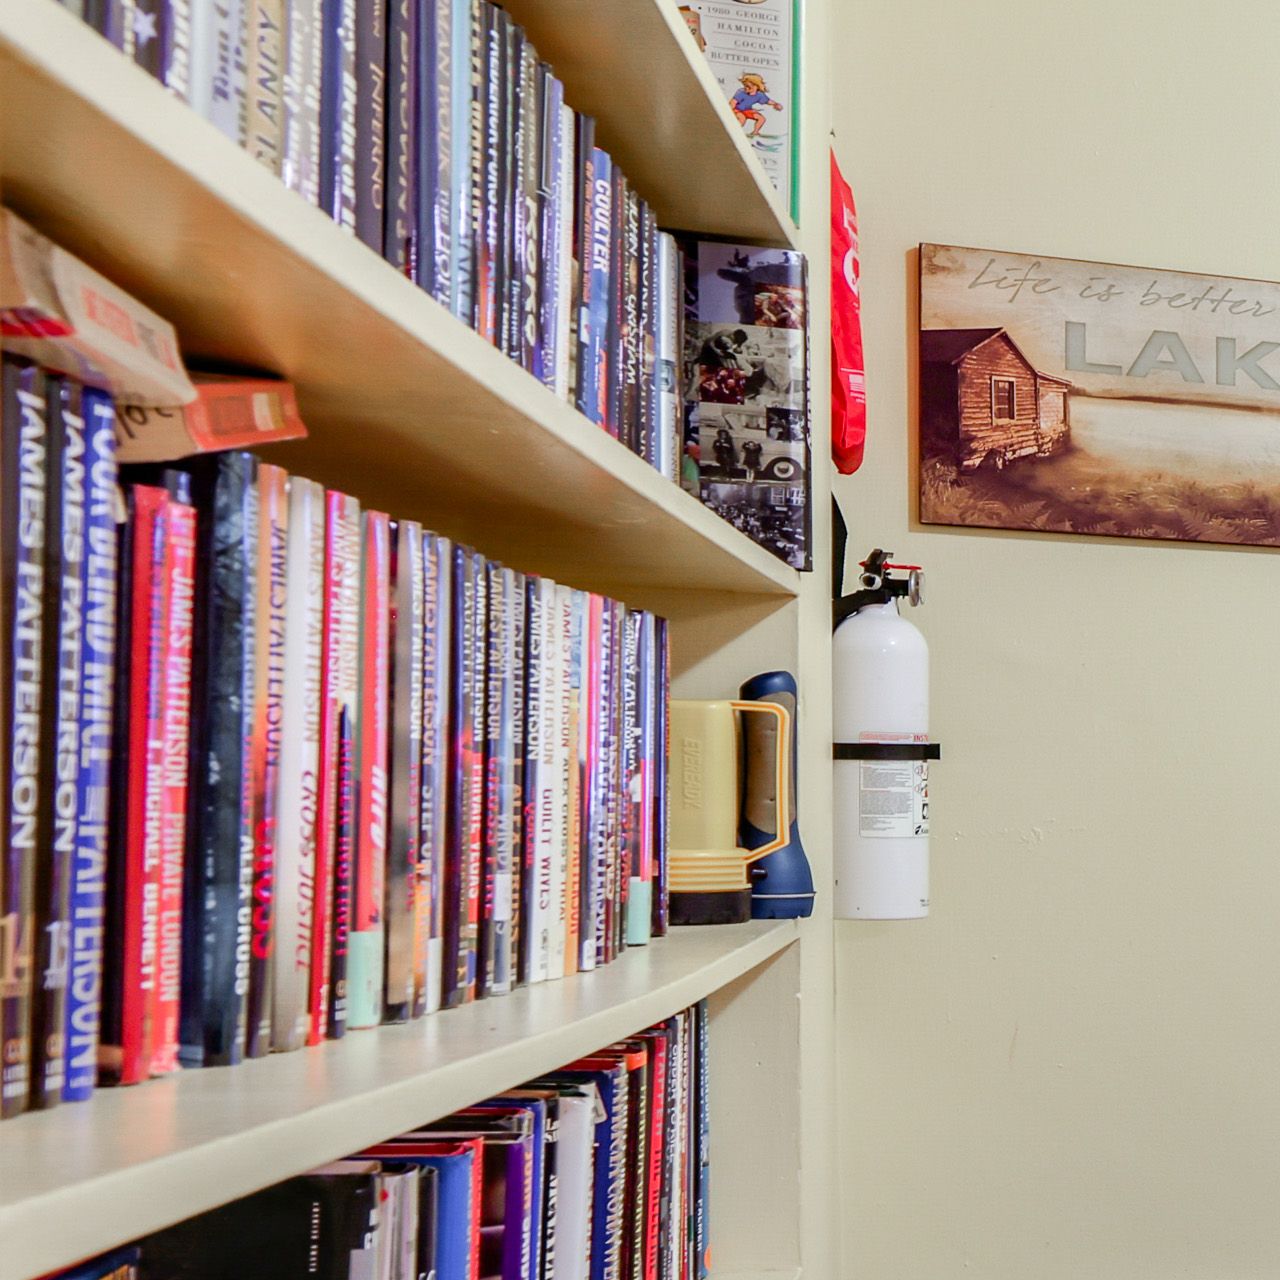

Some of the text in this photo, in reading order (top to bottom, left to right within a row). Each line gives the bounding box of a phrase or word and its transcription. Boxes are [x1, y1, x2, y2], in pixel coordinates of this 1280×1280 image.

[710, 51, 780, 67] BUTTER OPEN
[716, 22, 780, 37] HAMILTON
[735, 9, 780, 22] GEORGE
[369, 62, 385, 210] INFERNO
[524, 196, 538, 347] KOKO
[593, 179, 612, 272] COULTER
[966, 258, 1063, 302] Life
[1079, 277, 1123, 302] is
[1140, 279, 1272, 320] better
[11, 390, 45, 850] JAMES PATTERSON
[54, 410, 86, 852] JAMES PATTERSON
[85, 529, 115, 657] BLIND
[169, 567, 195, 650] JAMES
[423, 548, 439, 628] JAMES
[475, 574, 488, 637] JAMES
[489, 570, 503, 633] JAMES
[82, 663, 112, 768] MICE
[164, 654, 193, 789] PATTERSON
[410, 621, 424, 739] PATTERSON
[422, 631, 438, 766] PATTERSON
[473, 641, 487, 741] PATTERSON
[487, 641, 502, 740] PATTERSON
[527, 595, 543, 760] JAMES PATTERSON
[300, 769, 319, 860] CROSS
[541, 788, 553, 847] GUILTY
[295, 868, 314, 973] JUSTICE
[539, 856, 552, 911] WIVES
[595, 822, 608, 947] PATTERSON
[70, 822, 107, 1068] PATTERSON
[140, 883, 159, 990] BENNETT
[159, 911, 184, 1002] LONDON
